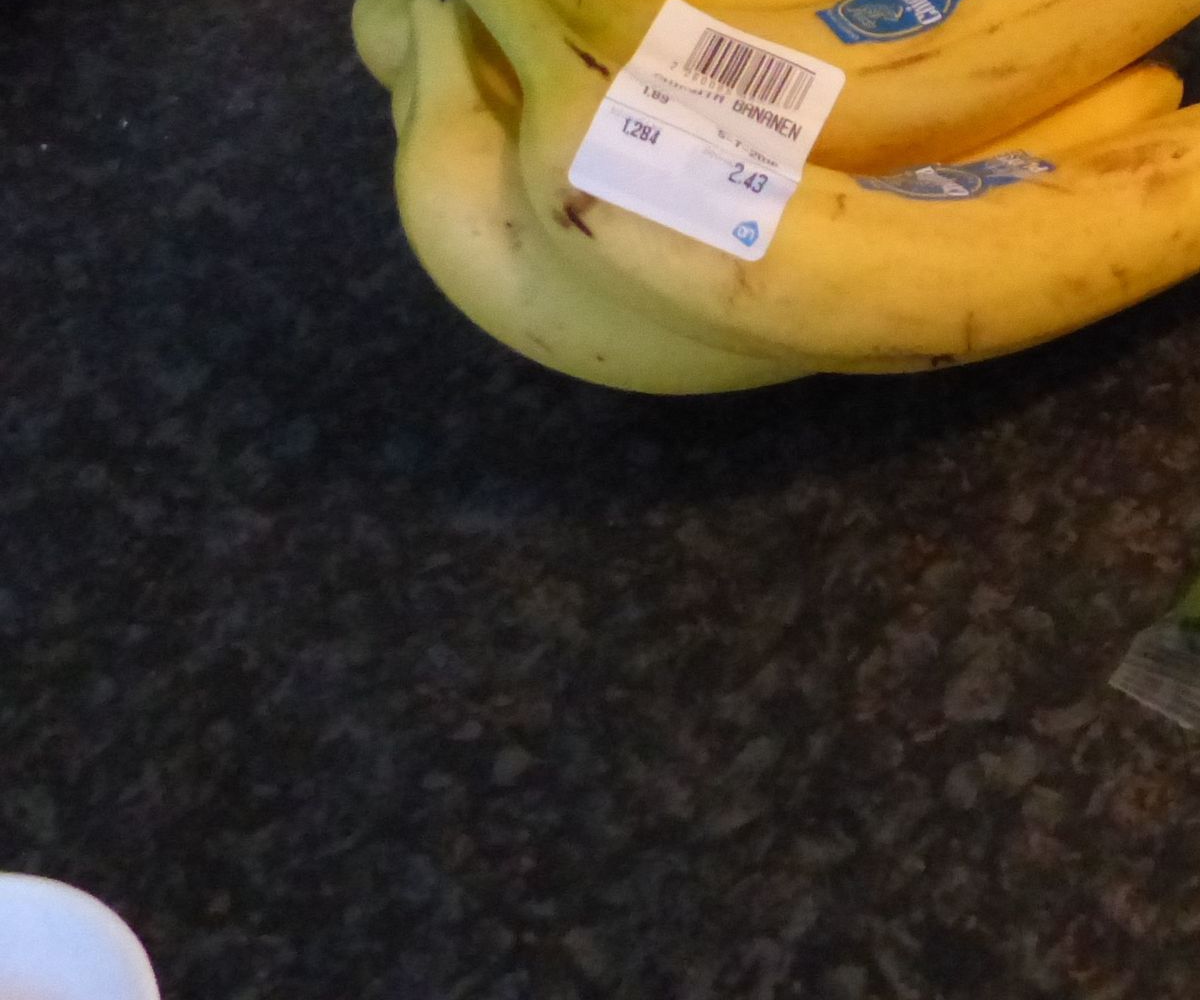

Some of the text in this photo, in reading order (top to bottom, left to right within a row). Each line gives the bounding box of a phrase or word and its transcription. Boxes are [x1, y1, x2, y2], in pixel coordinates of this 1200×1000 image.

[643, 85, 670, 105] 1.89
[621, 117, 662, 145] 1.284
[732, 98, 803, 142] BANANEN
[728, 161, 769, 193] 2.43
